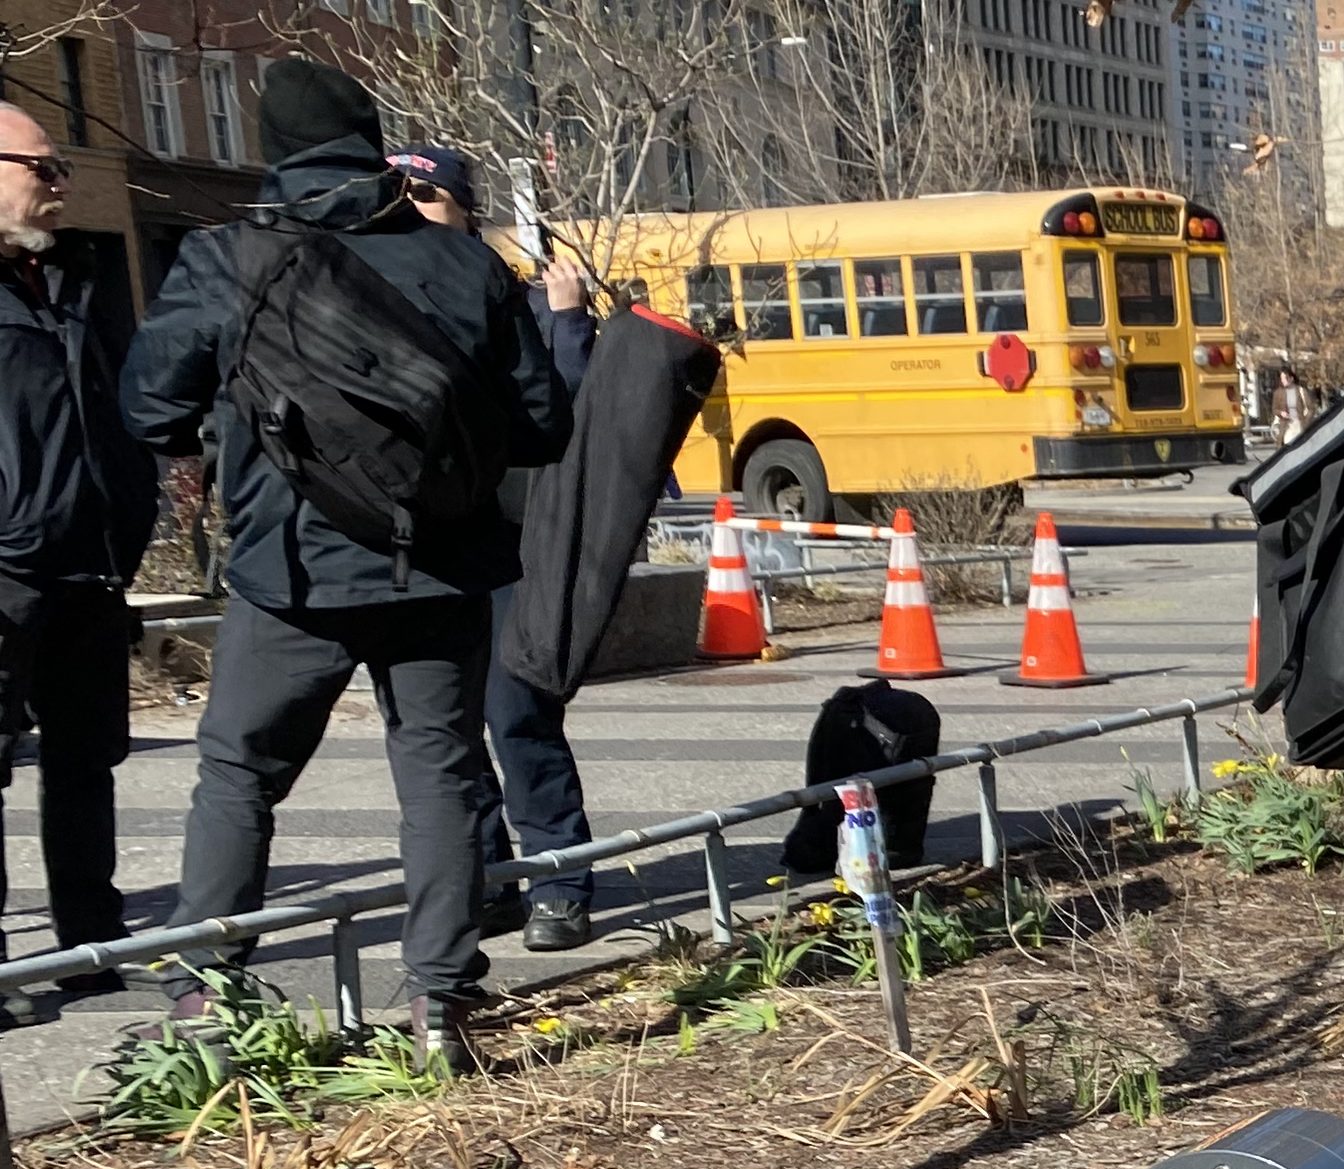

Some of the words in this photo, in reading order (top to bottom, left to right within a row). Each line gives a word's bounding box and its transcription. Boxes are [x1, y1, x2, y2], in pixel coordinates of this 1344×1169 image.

[1105, 205, 1152, 231] SCHOOL
[1154, 206, 1176, 231] BUS
[890, 359, 941, 371] OPERATOR
